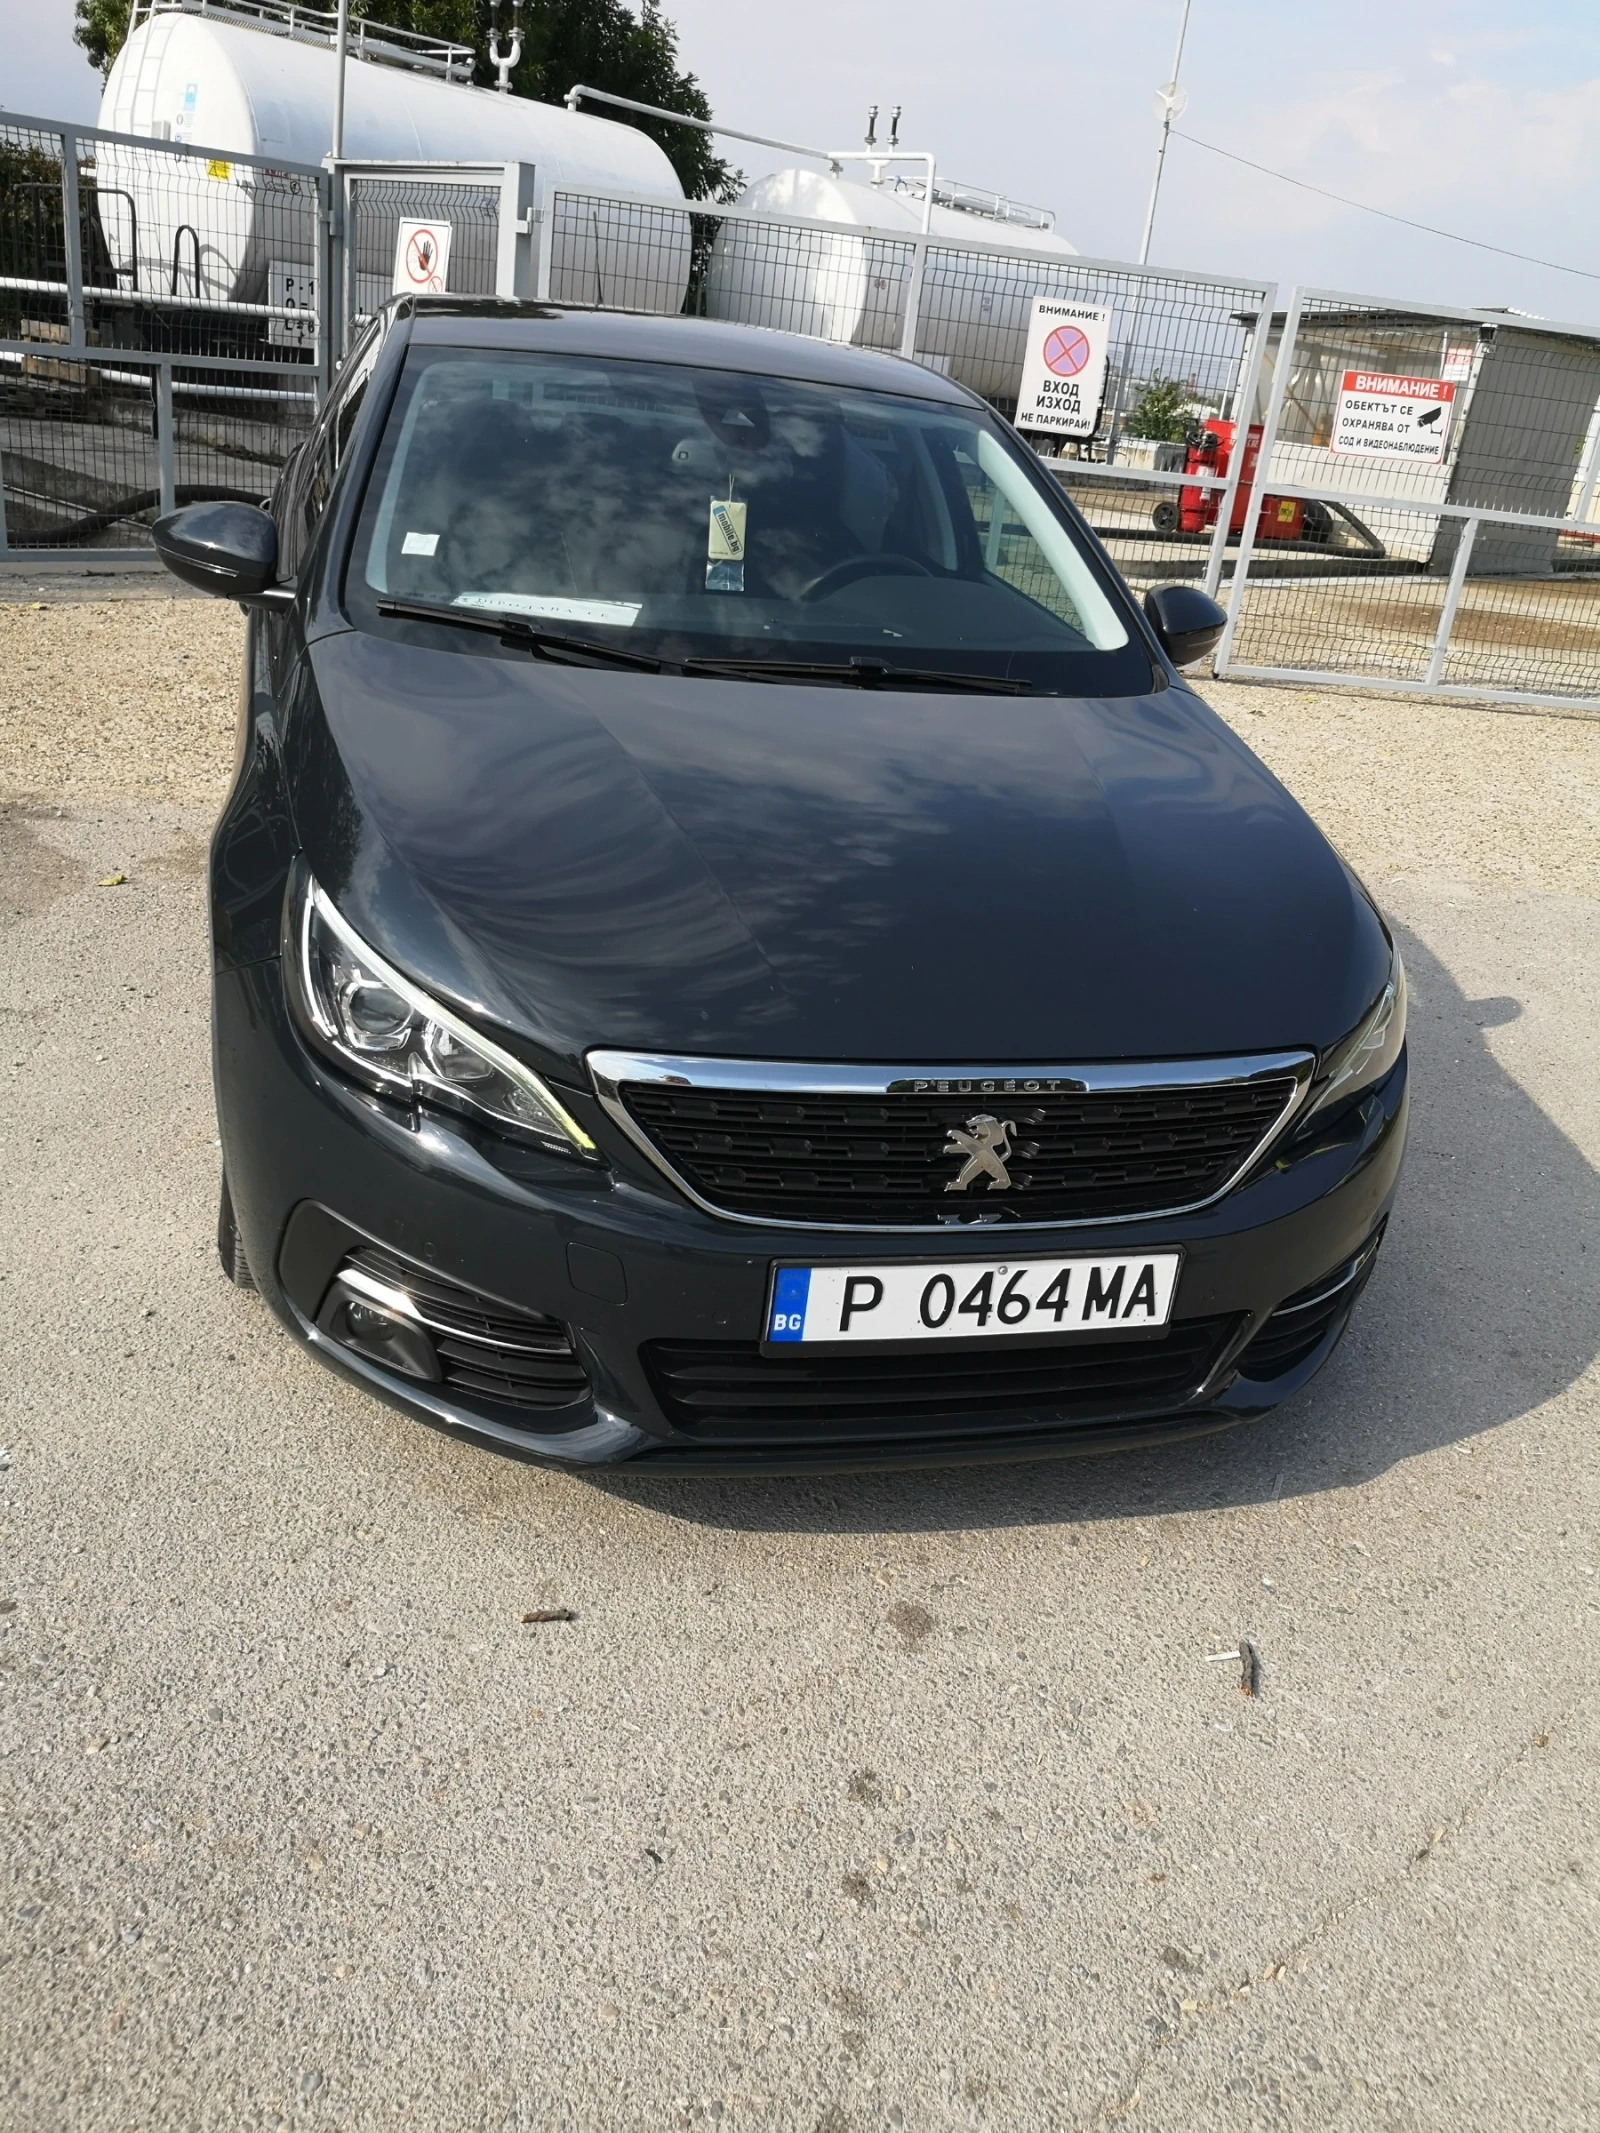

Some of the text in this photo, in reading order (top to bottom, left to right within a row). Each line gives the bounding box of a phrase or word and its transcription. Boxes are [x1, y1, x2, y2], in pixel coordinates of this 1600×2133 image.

[1039, 305, 1099, 321] ВНИМАНИЕ
[1042, 380, 1080, 398] ВХОД
[1355, 376, 1440, 398] ВНИМАНИЕ
[1035, 395, 1082, 414] ИЗХОД
[1345, 400, 1413, 415] ОБЕКТЪТ СЕ
[1020, 412, 1091, 431] НЕ ПАРКИРАЙ!
[1341, 417, 1411, 434] ОХРАНЯВА ОТ
[1338, 435, 1440, 456] СОД И ВИДЕОНАБЛЮДЕНИЕ
[717, 512, 741, 553] mobile.bg
[914, 1079, 1061, 1093] PEUGEOT
[773, 1313, 802, 1331] BG
